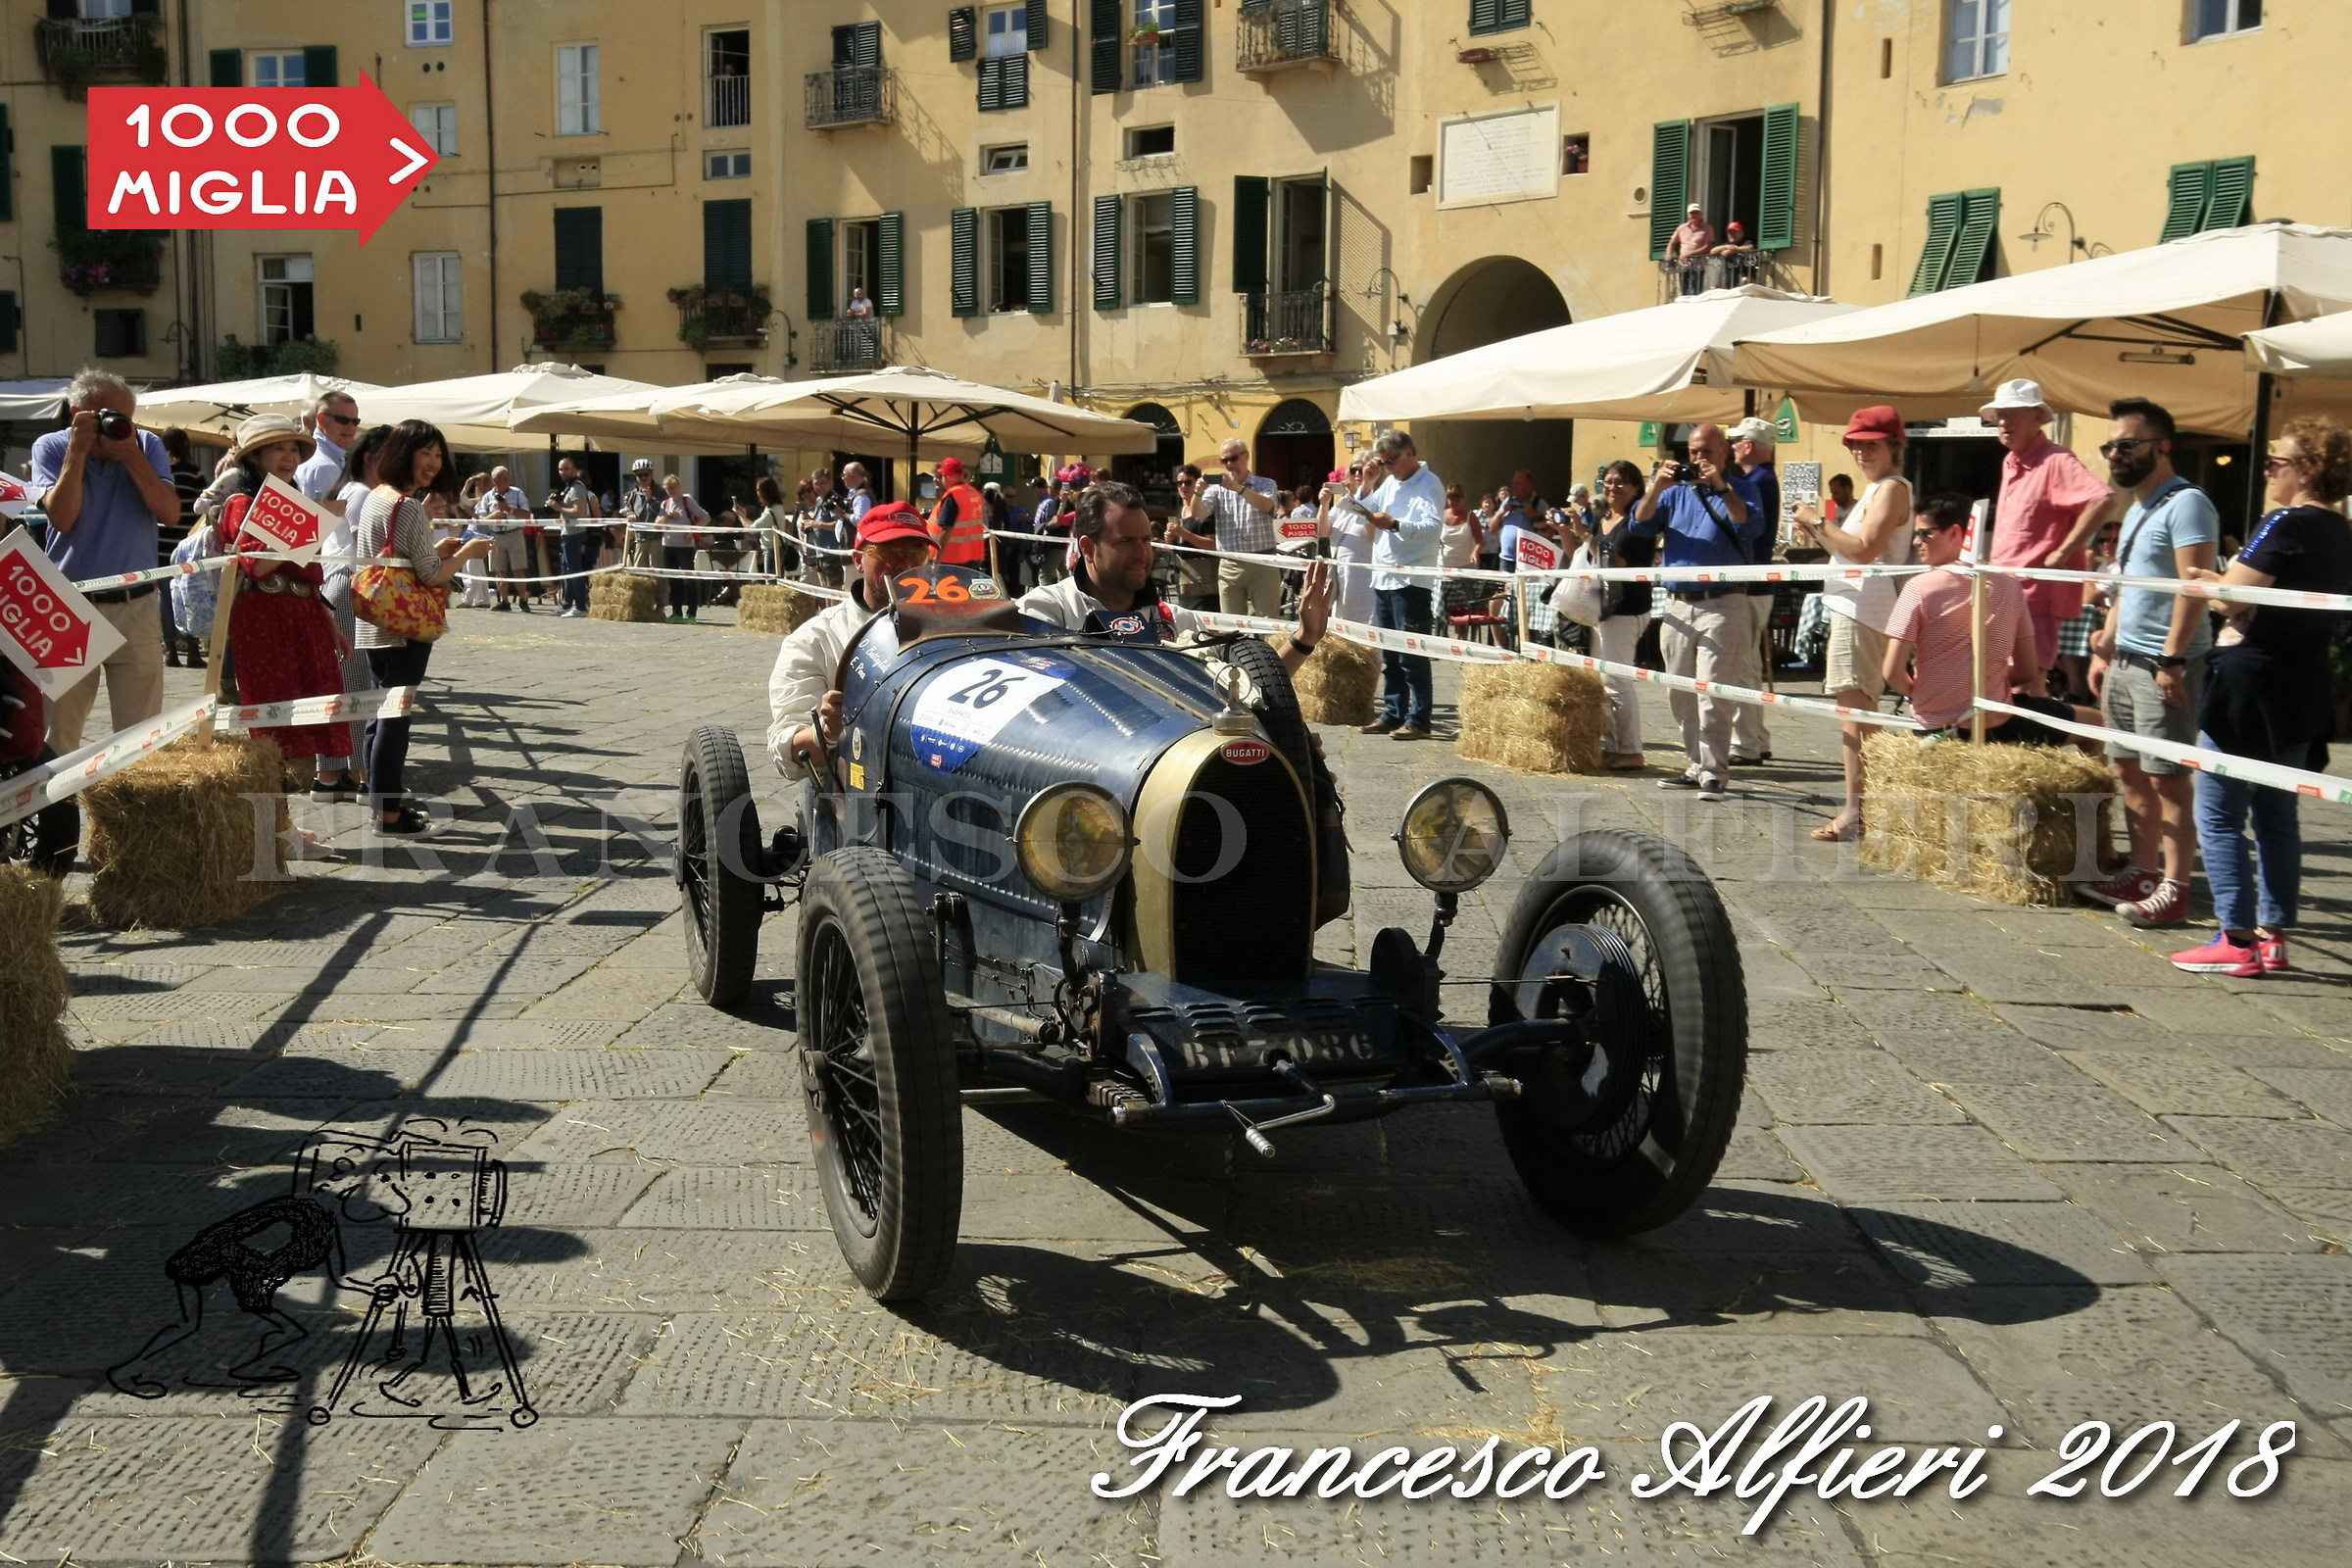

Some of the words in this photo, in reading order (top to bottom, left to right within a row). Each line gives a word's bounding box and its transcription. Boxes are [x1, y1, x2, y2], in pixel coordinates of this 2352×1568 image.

[261, 491, 307, 525] 1000
[1521, 539, 1549, 559] 1000
[9, 565, 71, 632] 1000
[899, 575, 970, 604] 26
[0, 586, 53, 659] IGLIA
[947, 668, 1028, 710] 26
[1226, 749, 1264, 758] BUGATTI
